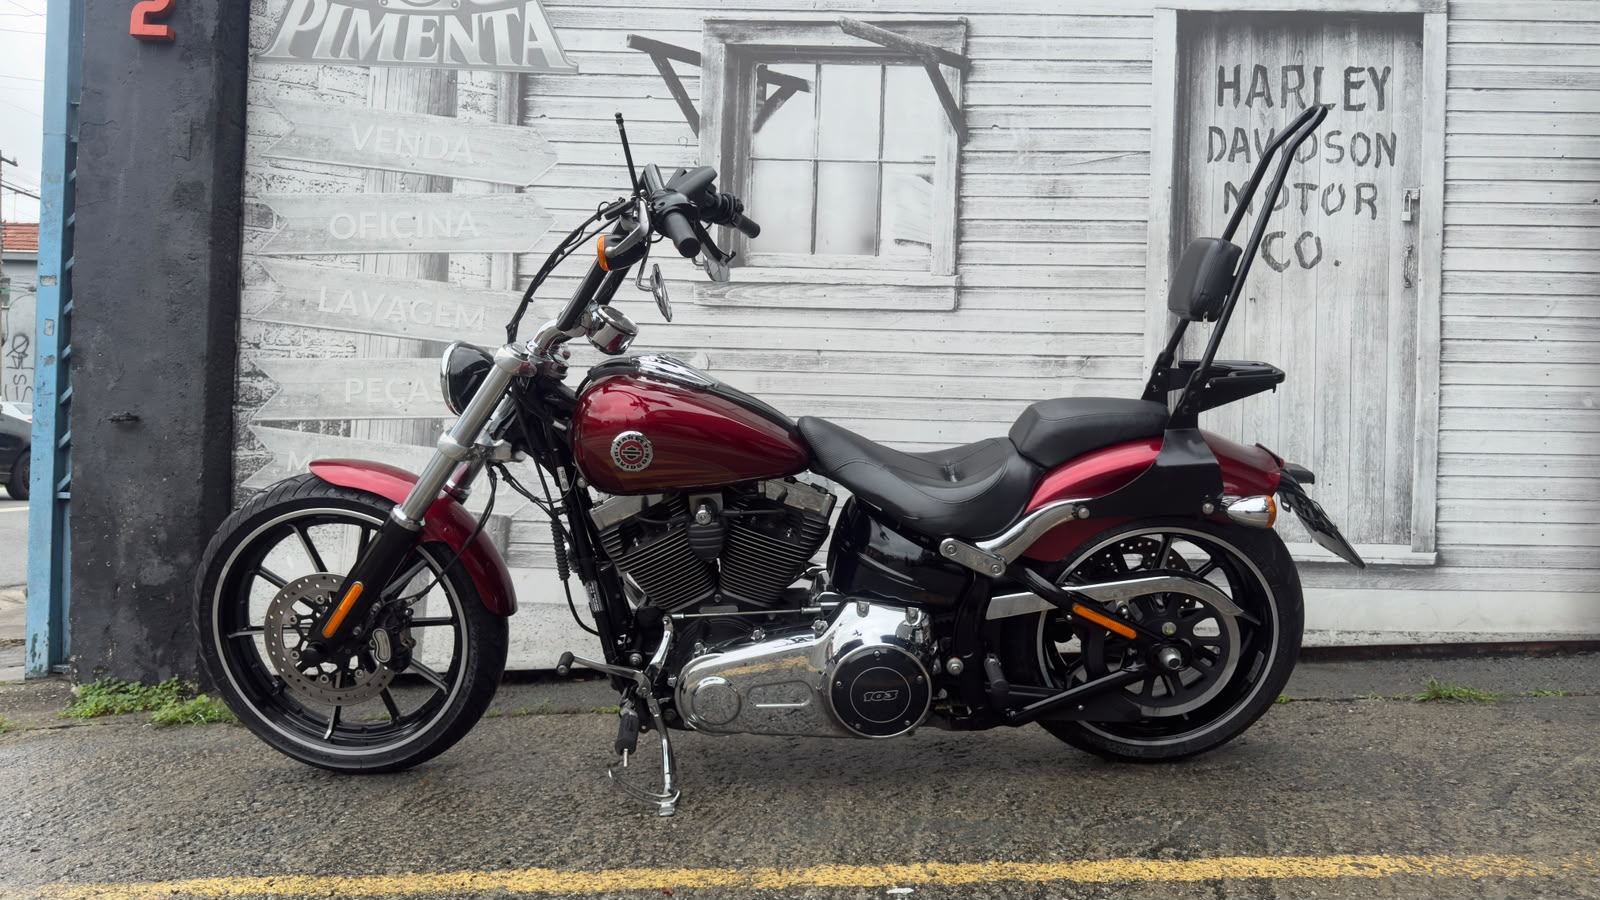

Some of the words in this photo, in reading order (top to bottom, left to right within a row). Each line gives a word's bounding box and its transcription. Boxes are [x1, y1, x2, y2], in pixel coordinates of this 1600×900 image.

[262, 0, 574, 68] PIMENTA
[1216, 63, 1392, 112] HARLEY
[351, 121, 474, 164] VENDA
[1207, 126, 1397, 168] DAVDSON
[1223, 181, 1379, 220] MOTOR
[329, 210, 480, 240] OFICINA
[1260, 231, 1342, 273] CO.
[317, 286, 485, 331] LAVAGEM
[863, 689, 899, 702] 103
